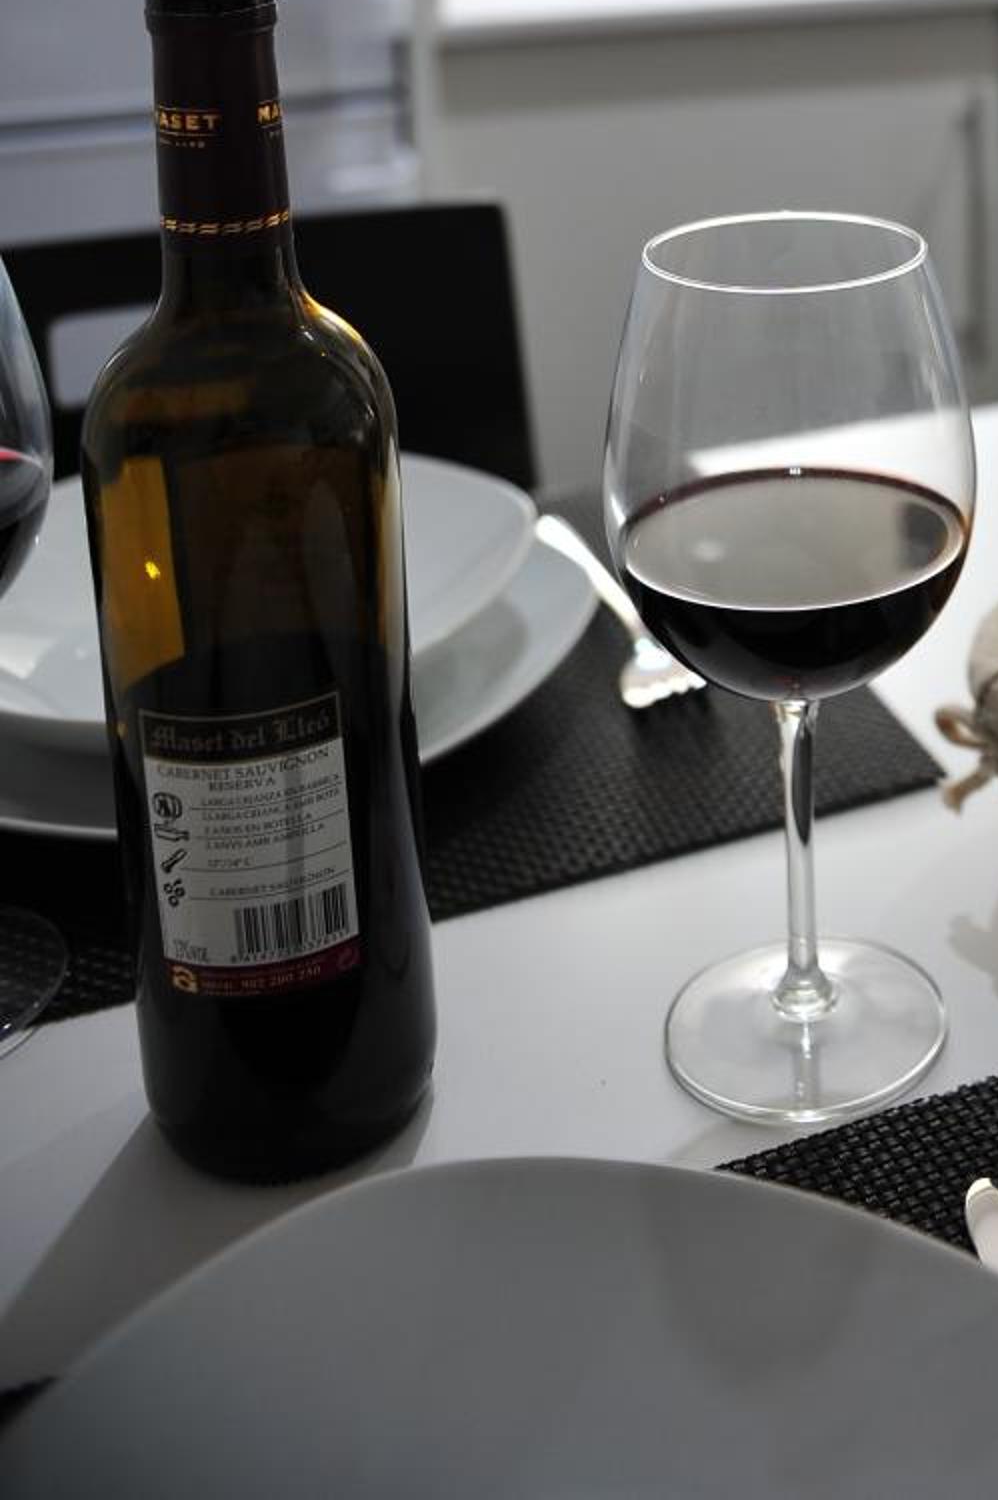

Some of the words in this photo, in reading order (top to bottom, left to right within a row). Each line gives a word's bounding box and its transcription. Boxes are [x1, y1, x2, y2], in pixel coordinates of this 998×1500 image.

[157, 111, 216, 131] ASET
[157, 764, 231, 782] CABERNET
[236, 745, 330, 778] SAUVIGNON
[208, 775, 276, 792] RESERVA
